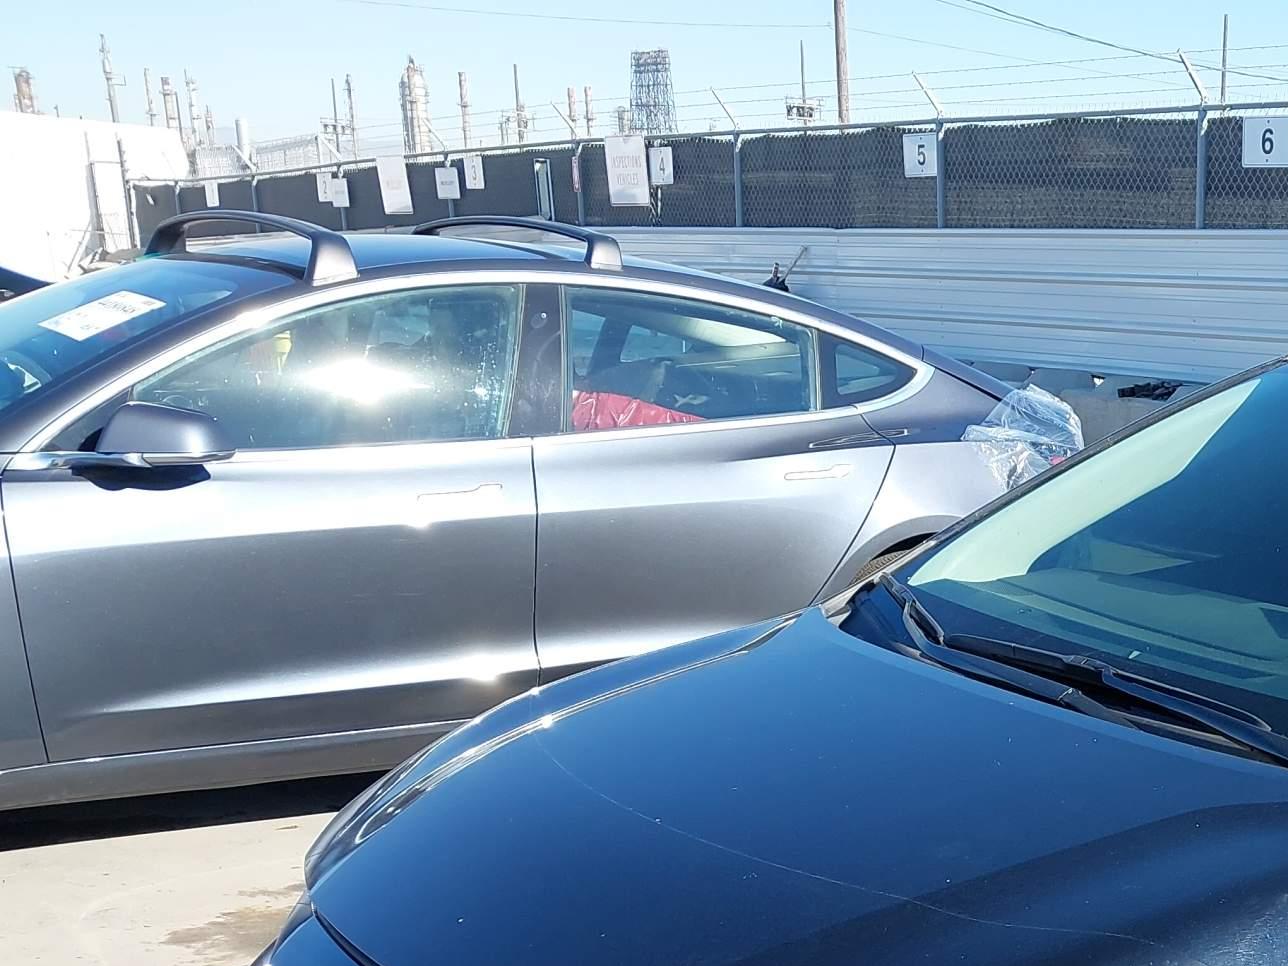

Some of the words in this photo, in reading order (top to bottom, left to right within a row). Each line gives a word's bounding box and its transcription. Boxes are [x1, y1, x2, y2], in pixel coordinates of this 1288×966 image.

[1261, 128, 1274, 155] 6
[917, 144, 926, 166] 5
[659, 157, 665, 176] 4
